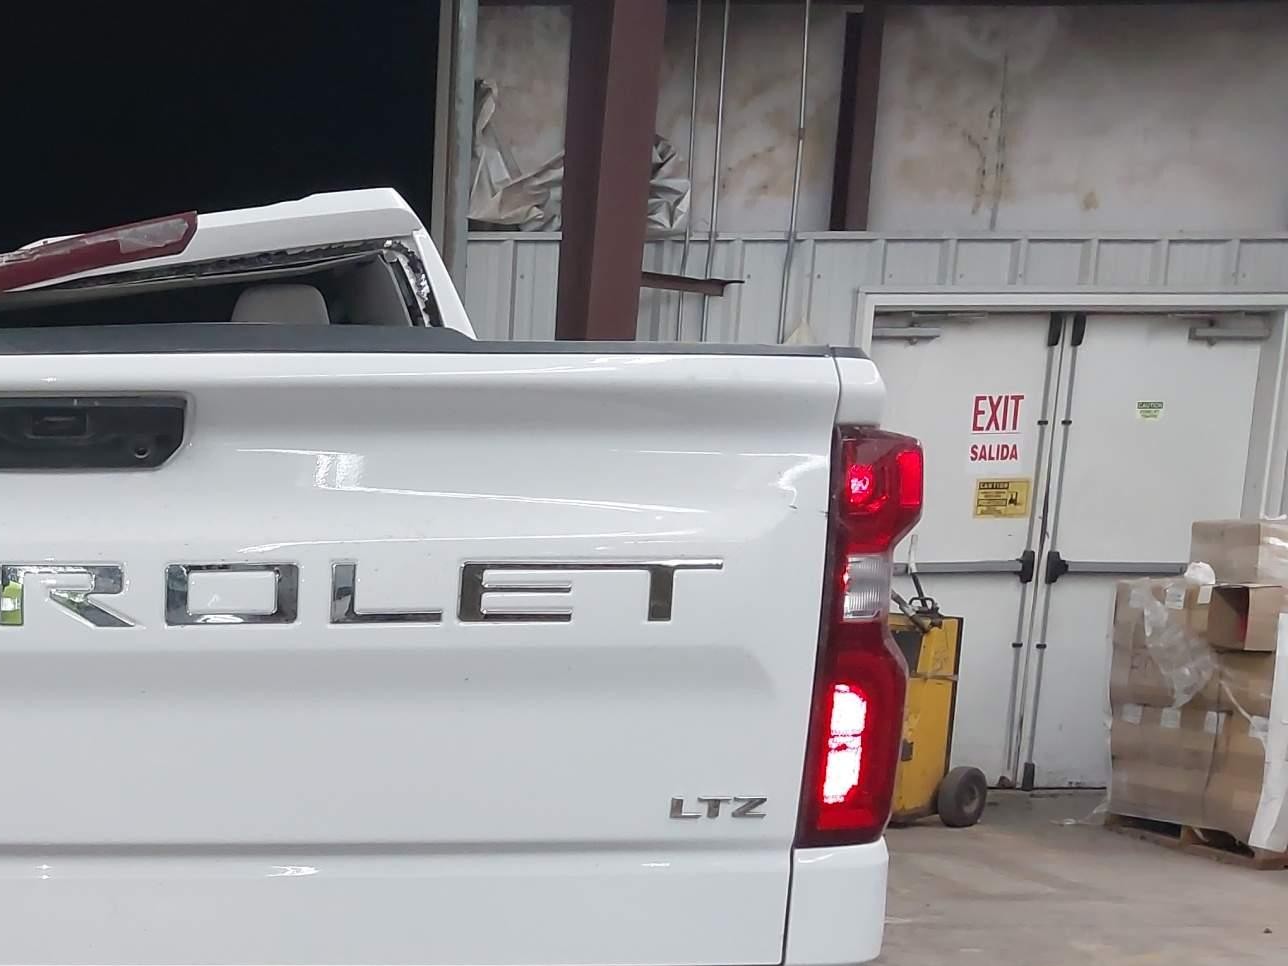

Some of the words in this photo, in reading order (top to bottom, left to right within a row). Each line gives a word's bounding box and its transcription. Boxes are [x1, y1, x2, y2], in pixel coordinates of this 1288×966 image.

[972, 394, 1025, 431] EXIT
[970, 443, 1018, 461] SALIDA
[669, 796, 768, 820] LTZ
